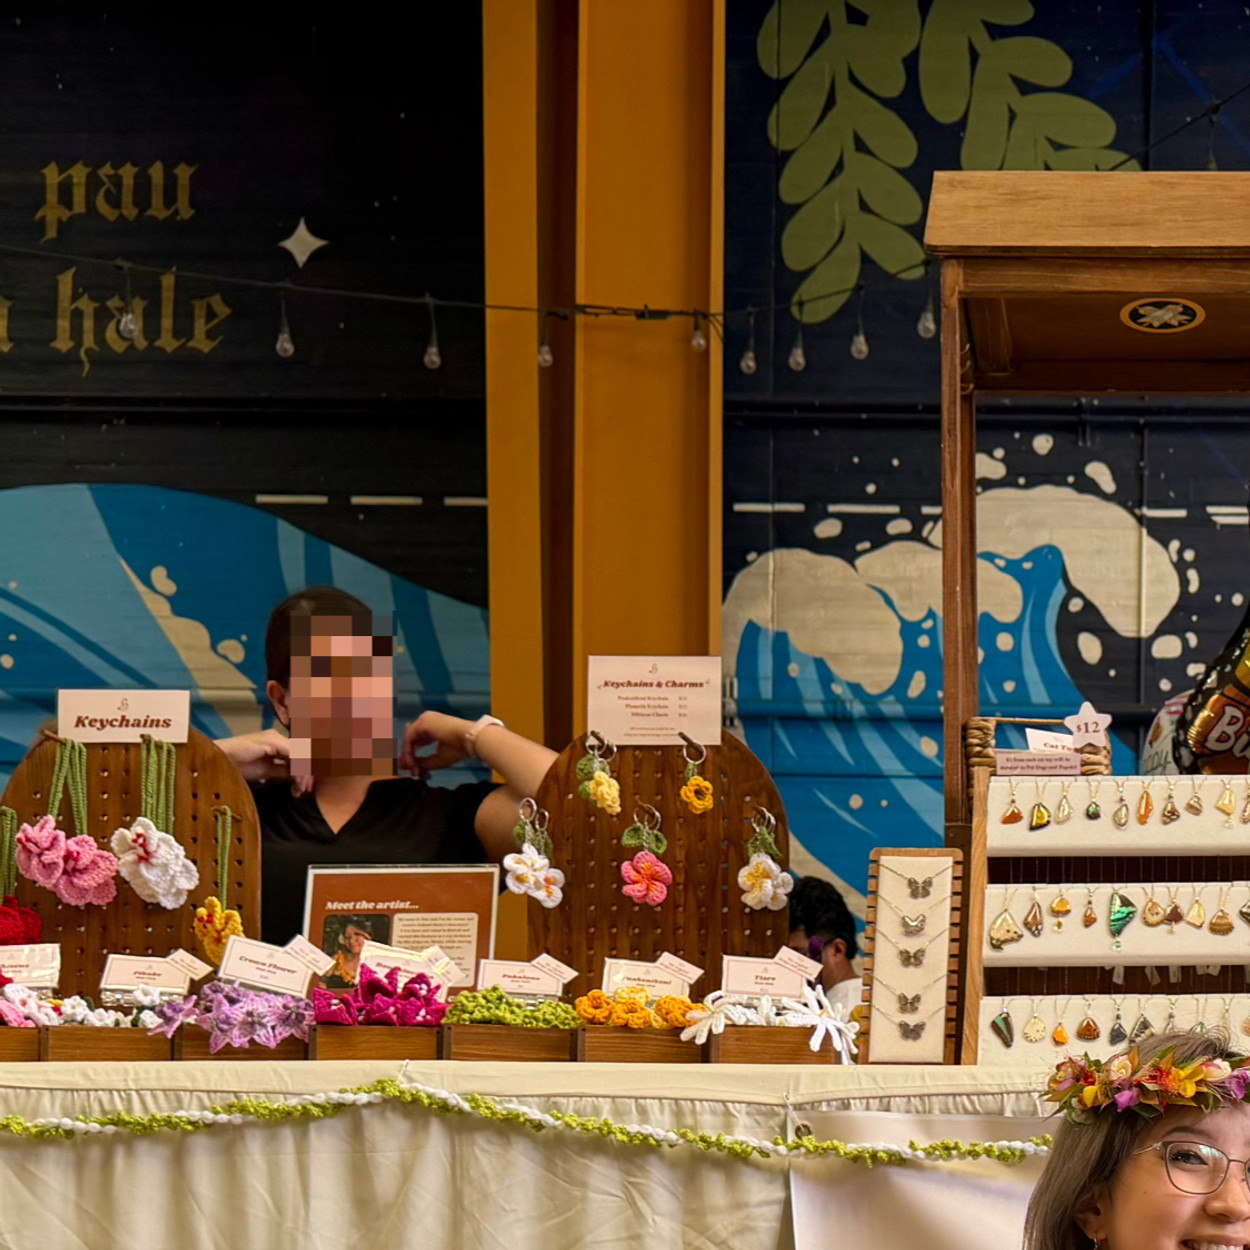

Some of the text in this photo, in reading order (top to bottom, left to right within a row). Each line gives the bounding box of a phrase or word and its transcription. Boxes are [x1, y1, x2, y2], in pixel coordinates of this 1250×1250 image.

[35, 160, 198, 243] pau
[50, 266, 232, 377] hale
[604, 680, 704, 689] Keychains & Charms
[74, 715, 172, 731] Keychains
[1076, 721, 1100, 734] $12
[1043, 742, 1059, 750] Cat
[325, 900, 419, 910] Meet the artist...
